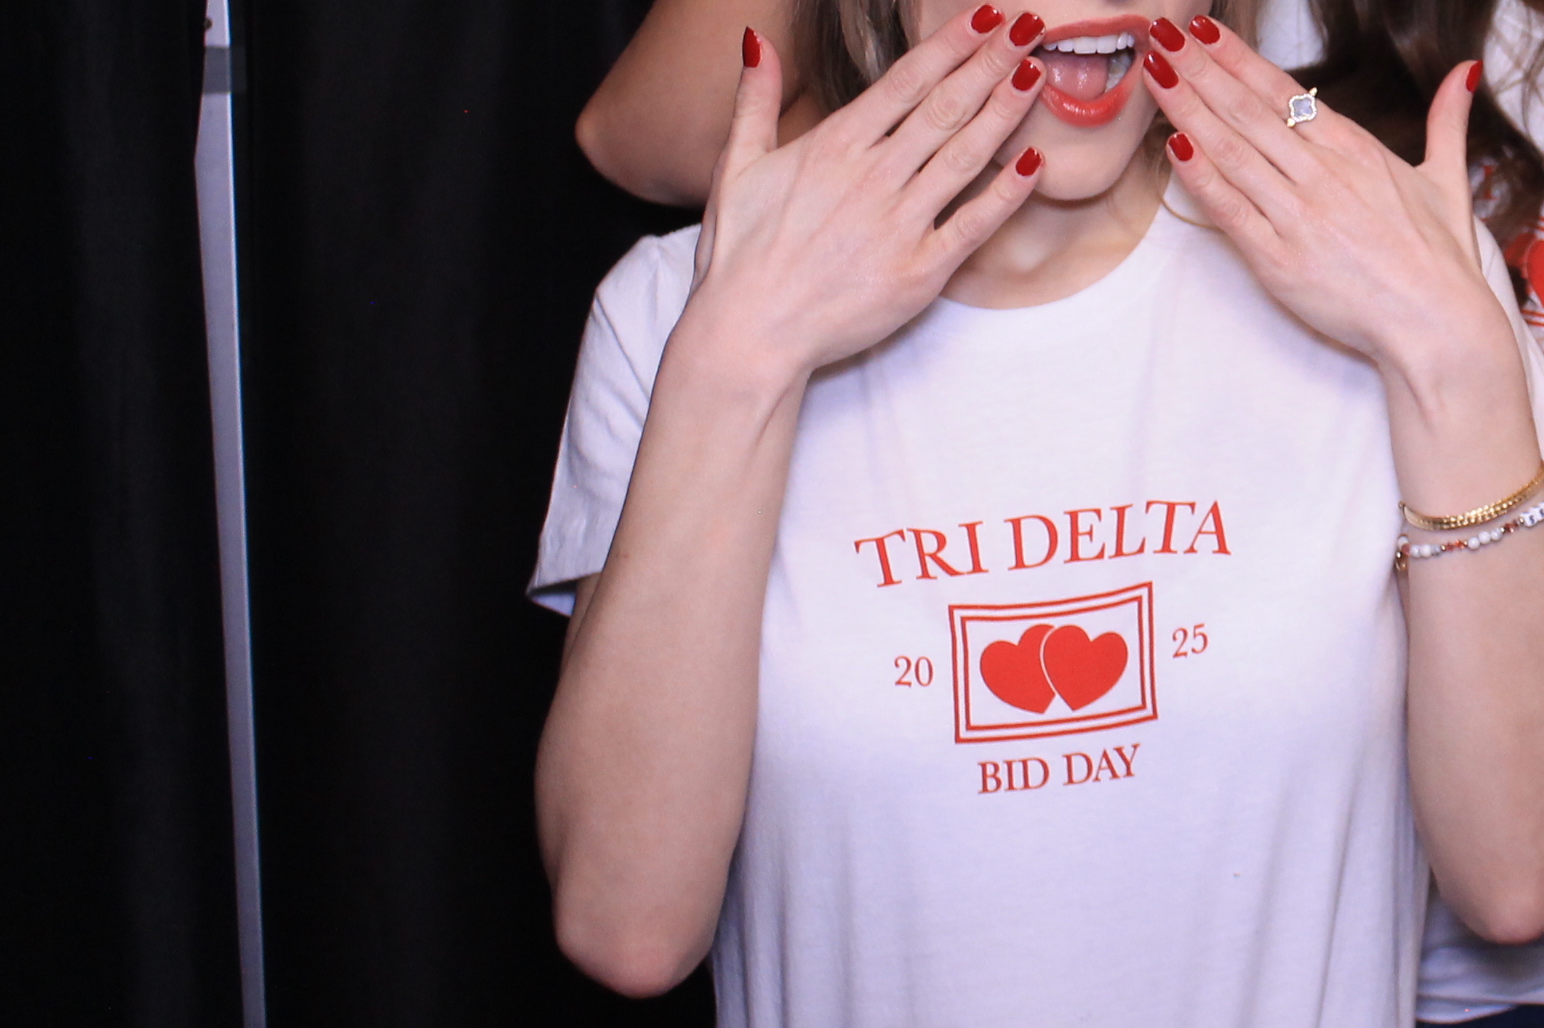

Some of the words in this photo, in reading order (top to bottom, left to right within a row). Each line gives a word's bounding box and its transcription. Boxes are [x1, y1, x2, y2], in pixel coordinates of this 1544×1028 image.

[854, 521, 989, 588] TRI
[1004, 500, 1231, 571] DELTA
[1172, 623, 1209, 658] 25
[894, 656, 934, 687] 20
[978, 757, 1051, 794] BID
[1062, 743, 1141, 786] DAY
